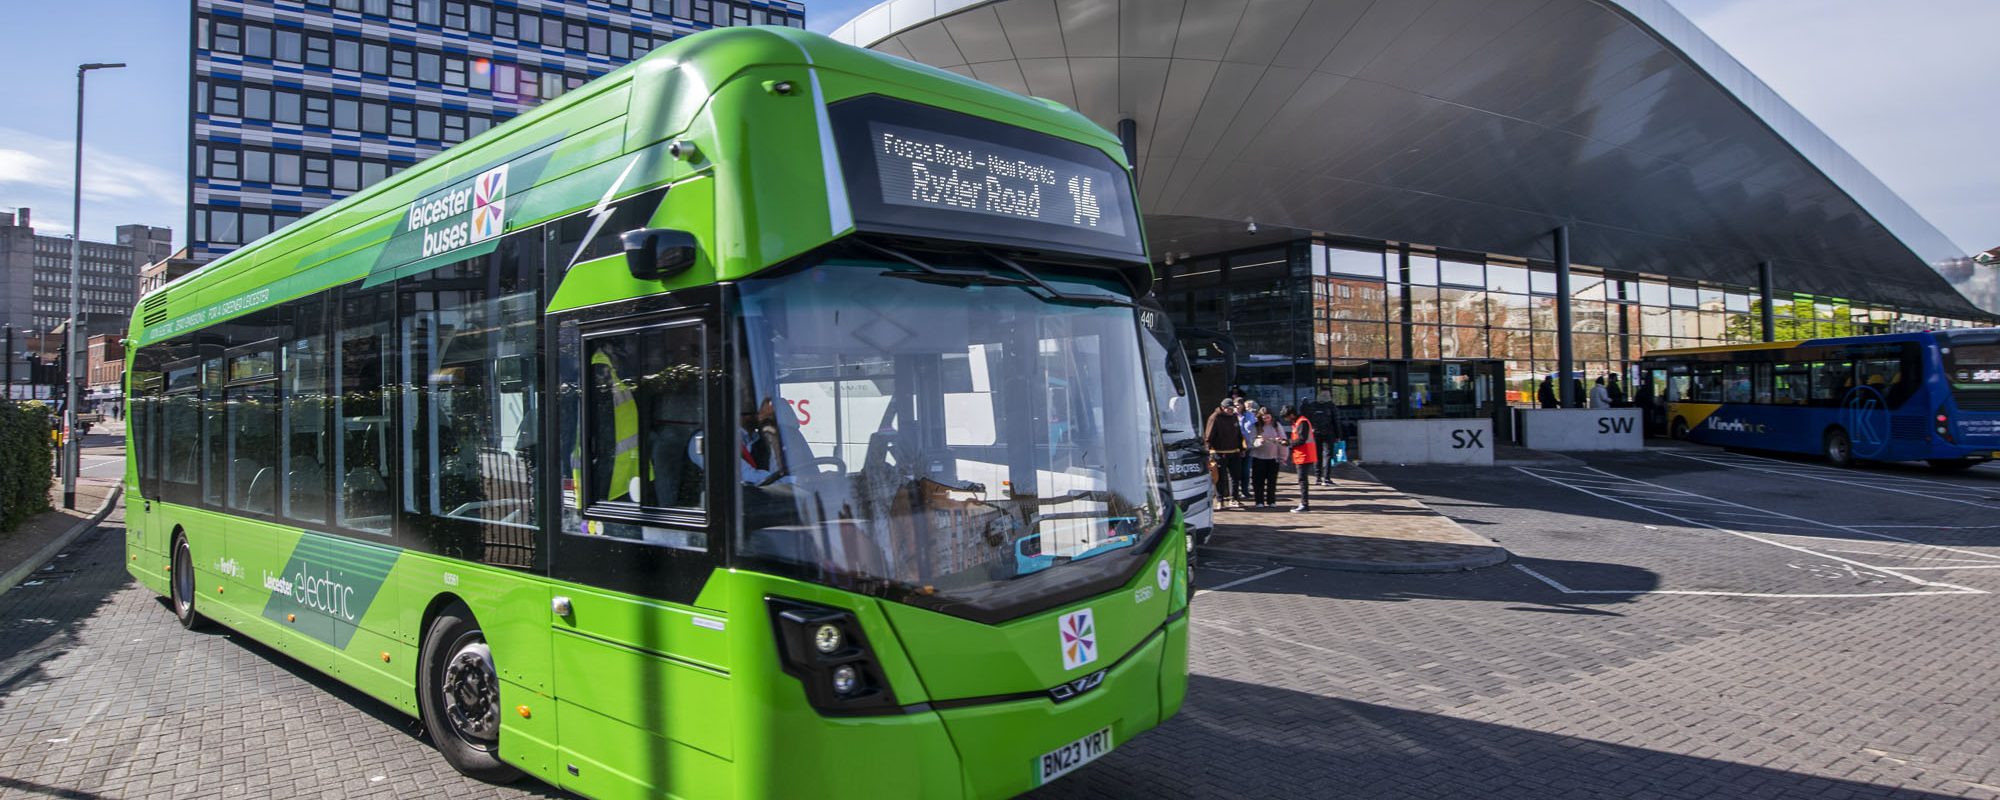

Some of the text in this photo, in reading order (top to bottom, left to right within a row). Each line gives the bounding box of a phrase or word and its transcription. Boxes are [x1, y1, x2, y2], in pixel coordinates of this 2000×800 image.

[884, 133, 934, 162] Fosse
[935, 143, 974, 169] Road
[988, 154, 1016, 178] New
[1018, 161, 1056, 185] Parks
[408, 187, 473, 232] leicester
[912, 162, 1041, 218] Ryder Road
[1068, 175, 1100, 227] 14
[422, 221, 469, 258] buses
[1140, 311, 1154, 330] 440
[1452, 429, 1484, 449] SX
[1598, 417, 1634, 434] SW
[263, 562, 355, 620] Leicester electric
[1043, 728, 1110, 778] BN23 YRT
